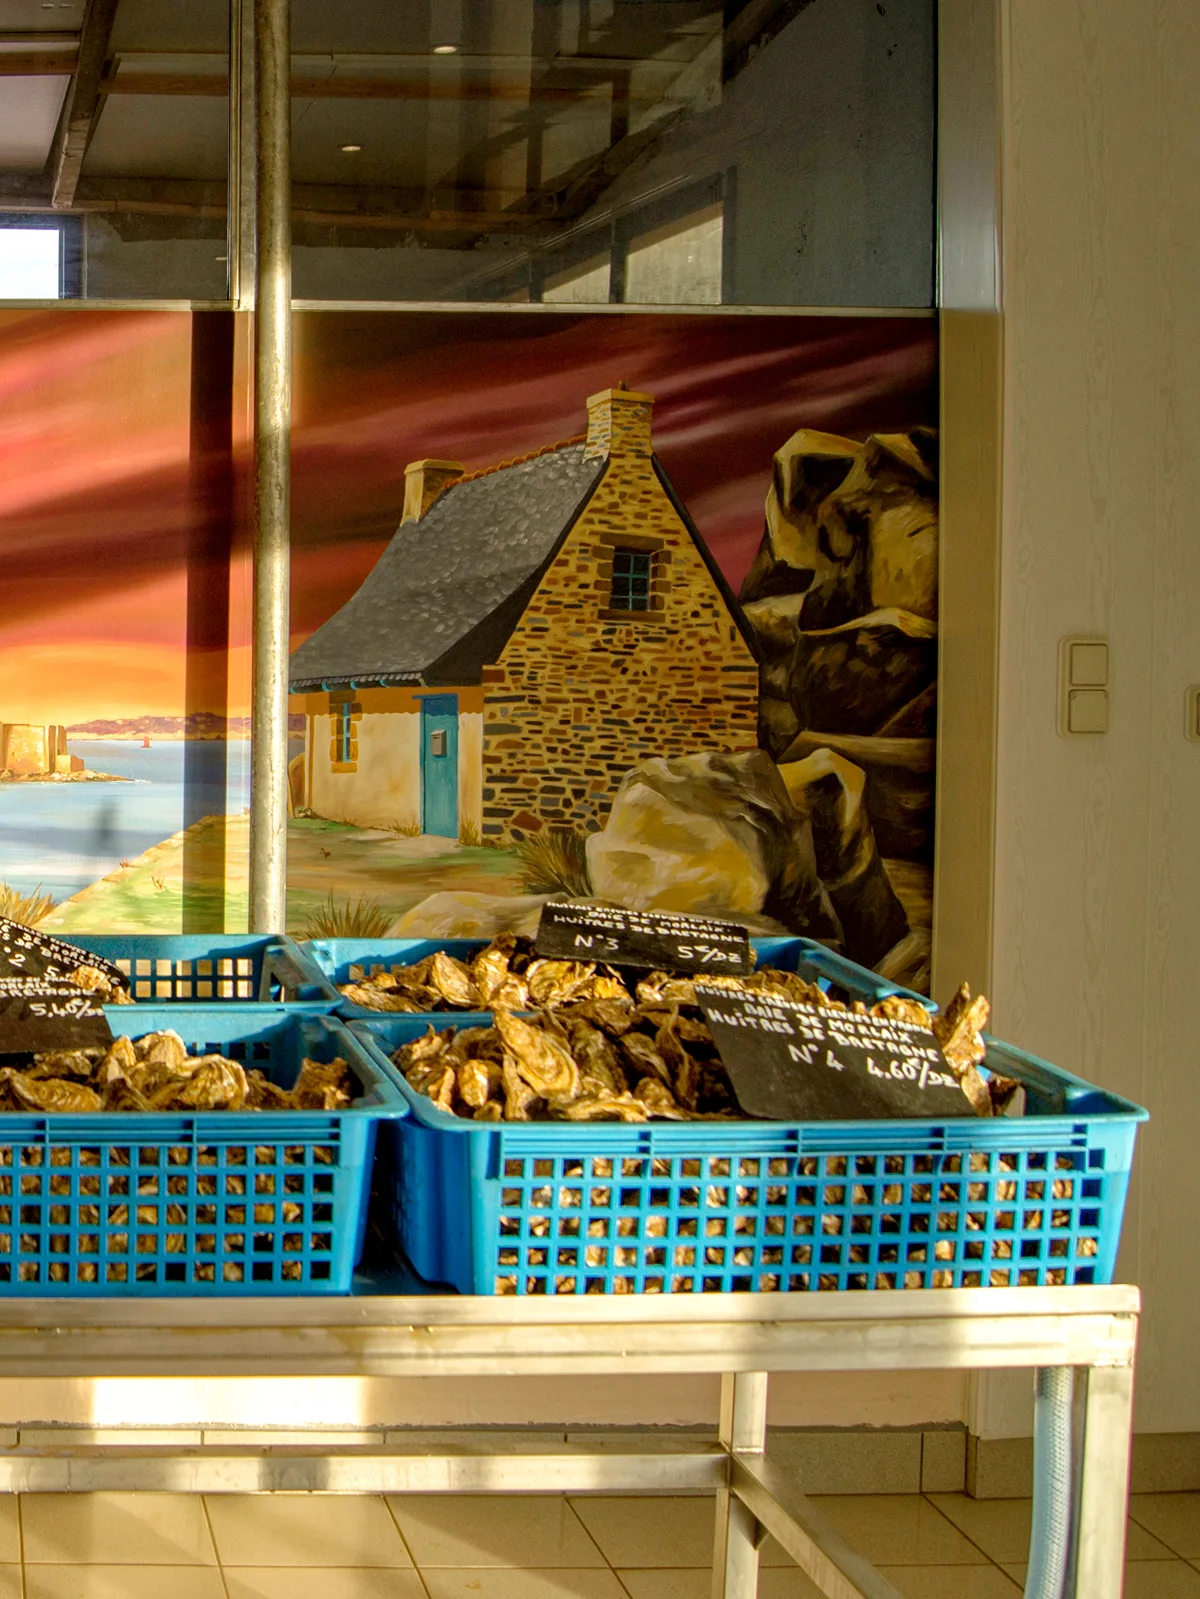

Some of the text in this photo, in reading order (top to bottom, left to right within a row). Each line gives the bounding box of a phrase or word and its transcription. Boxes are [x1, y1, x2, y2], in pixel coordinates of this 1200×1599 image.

[22, 932, 42, 946] DE
[656, 926, 745, 943] BRETAGNE
[14, 937, 35, 950] DE
[827, 1030, 940, 1063] BRETAGNE
